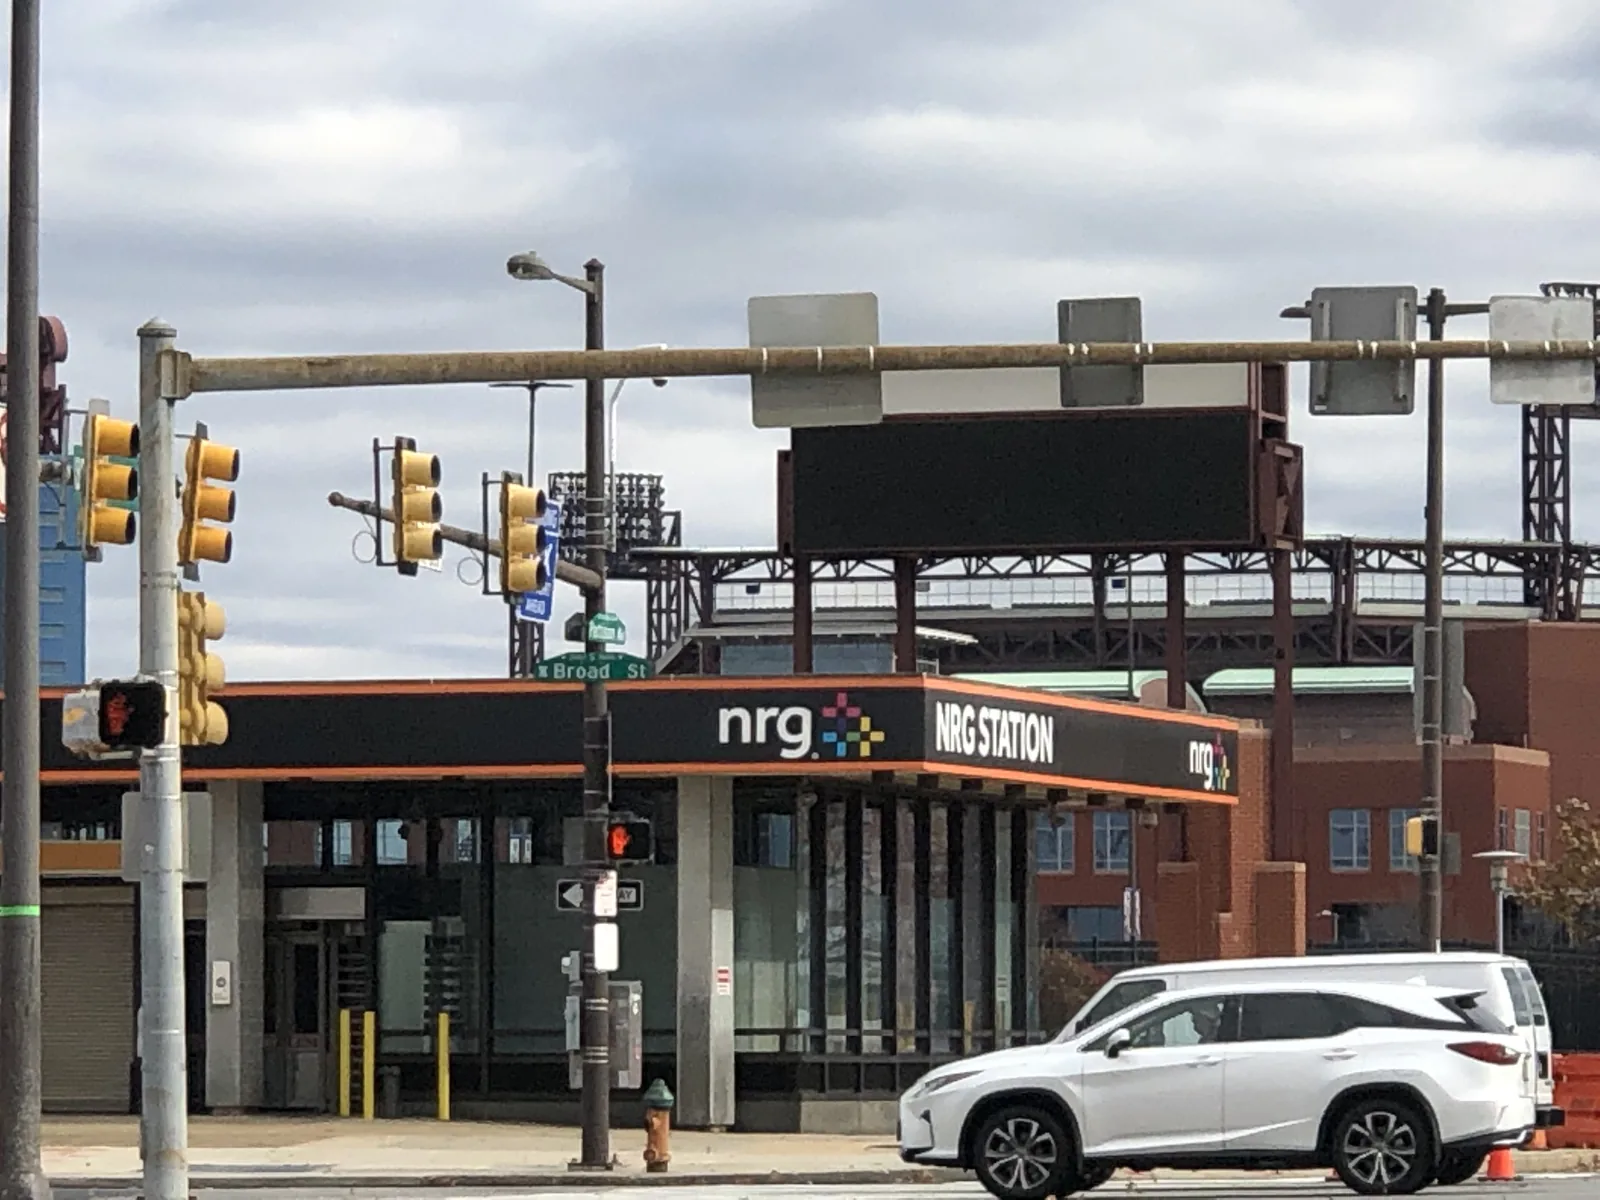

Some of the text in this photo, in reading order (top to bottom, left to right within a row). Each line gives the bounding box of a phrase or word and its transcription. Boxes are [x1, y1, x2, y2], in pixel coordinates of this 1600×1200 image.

[553, 662, 610, 680] Broad
[627, 663, 647, 679] St
[718, 706, 812, 760] nrg
[935, 700, 1054, 764] NRG STATION
[1189, 739, 1214, 792] nrg
[618, 888, 634, 901] AY
